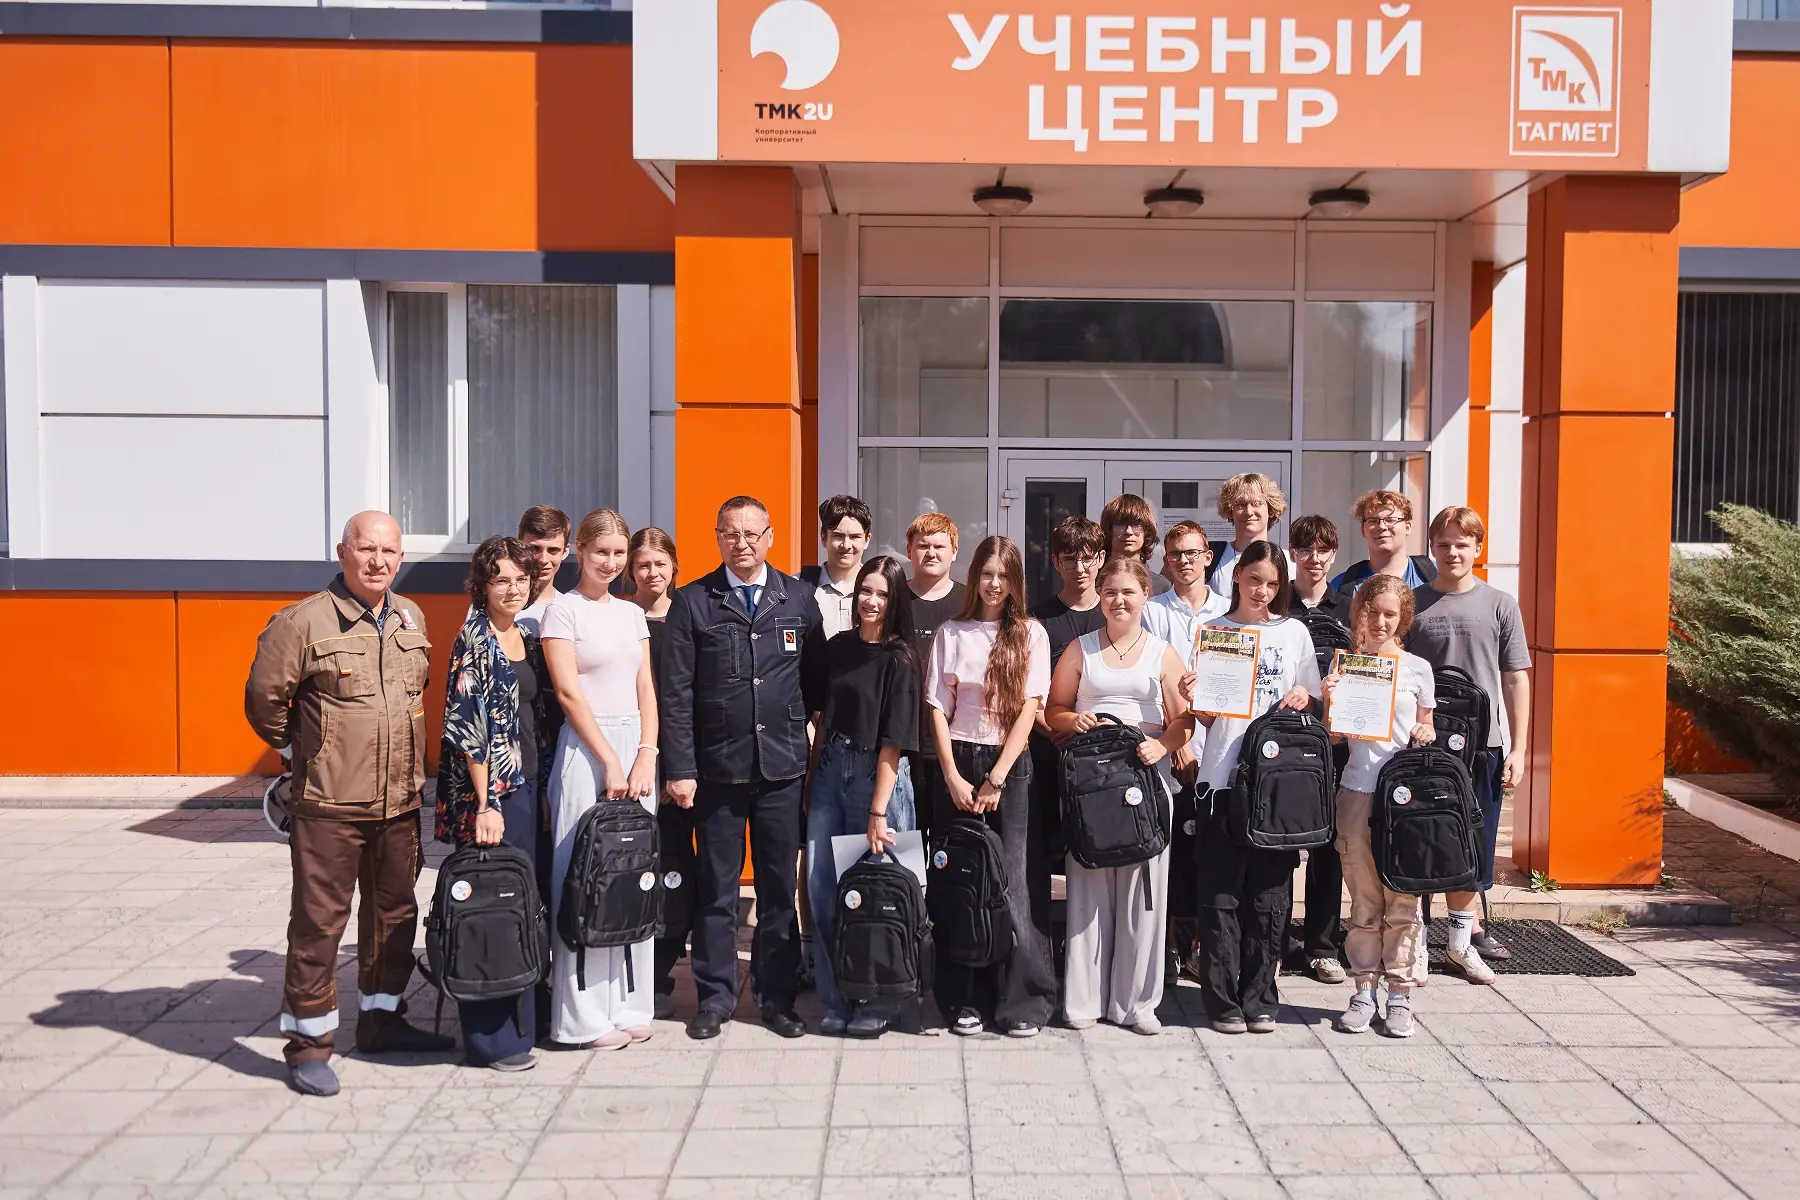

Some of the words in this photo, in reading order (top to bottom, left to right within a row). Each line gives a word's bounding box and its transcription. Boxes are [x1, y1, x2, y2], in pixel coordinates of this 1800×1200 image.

[947, 3, 1422, 76] УЧЕБНЫЙ
[1527, 57, 1587, 105] ТМК
[755, 128, 817, 136] Корпоративный
[1028, 85, 1338, 152] ЦЕНТР
[1517, 121, 1612, 142] ТАГМЕТ
